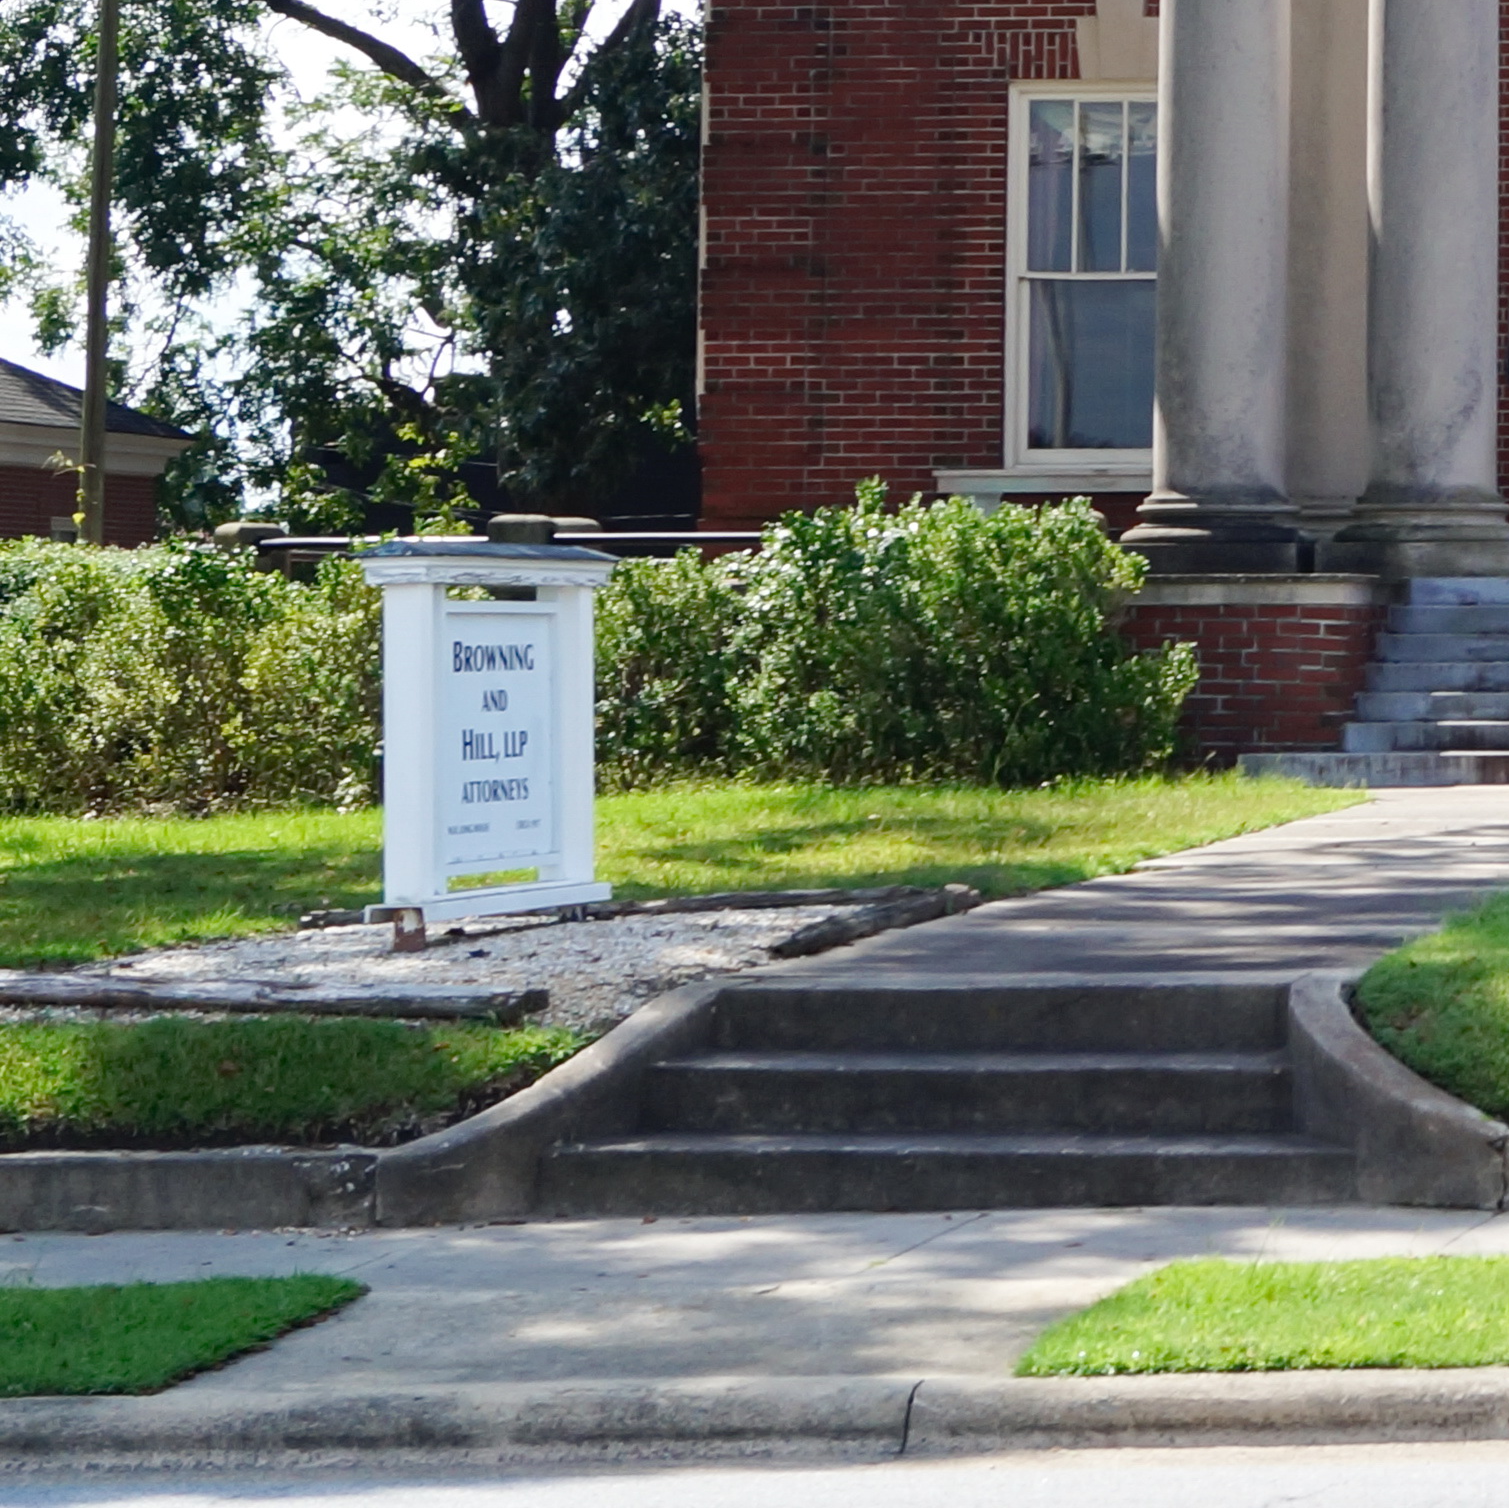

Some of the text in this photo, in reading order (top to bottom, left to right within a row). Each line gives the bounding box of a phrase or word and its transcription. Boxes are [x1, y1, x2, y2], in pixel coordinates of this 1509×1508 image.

[453, 641, 534, 672] BROWNING
[482, 689, 508, 712] AND
[462, 729, 528, 764] HILL, LLP
[461, 778, 529, 804] ATTORNEYS
